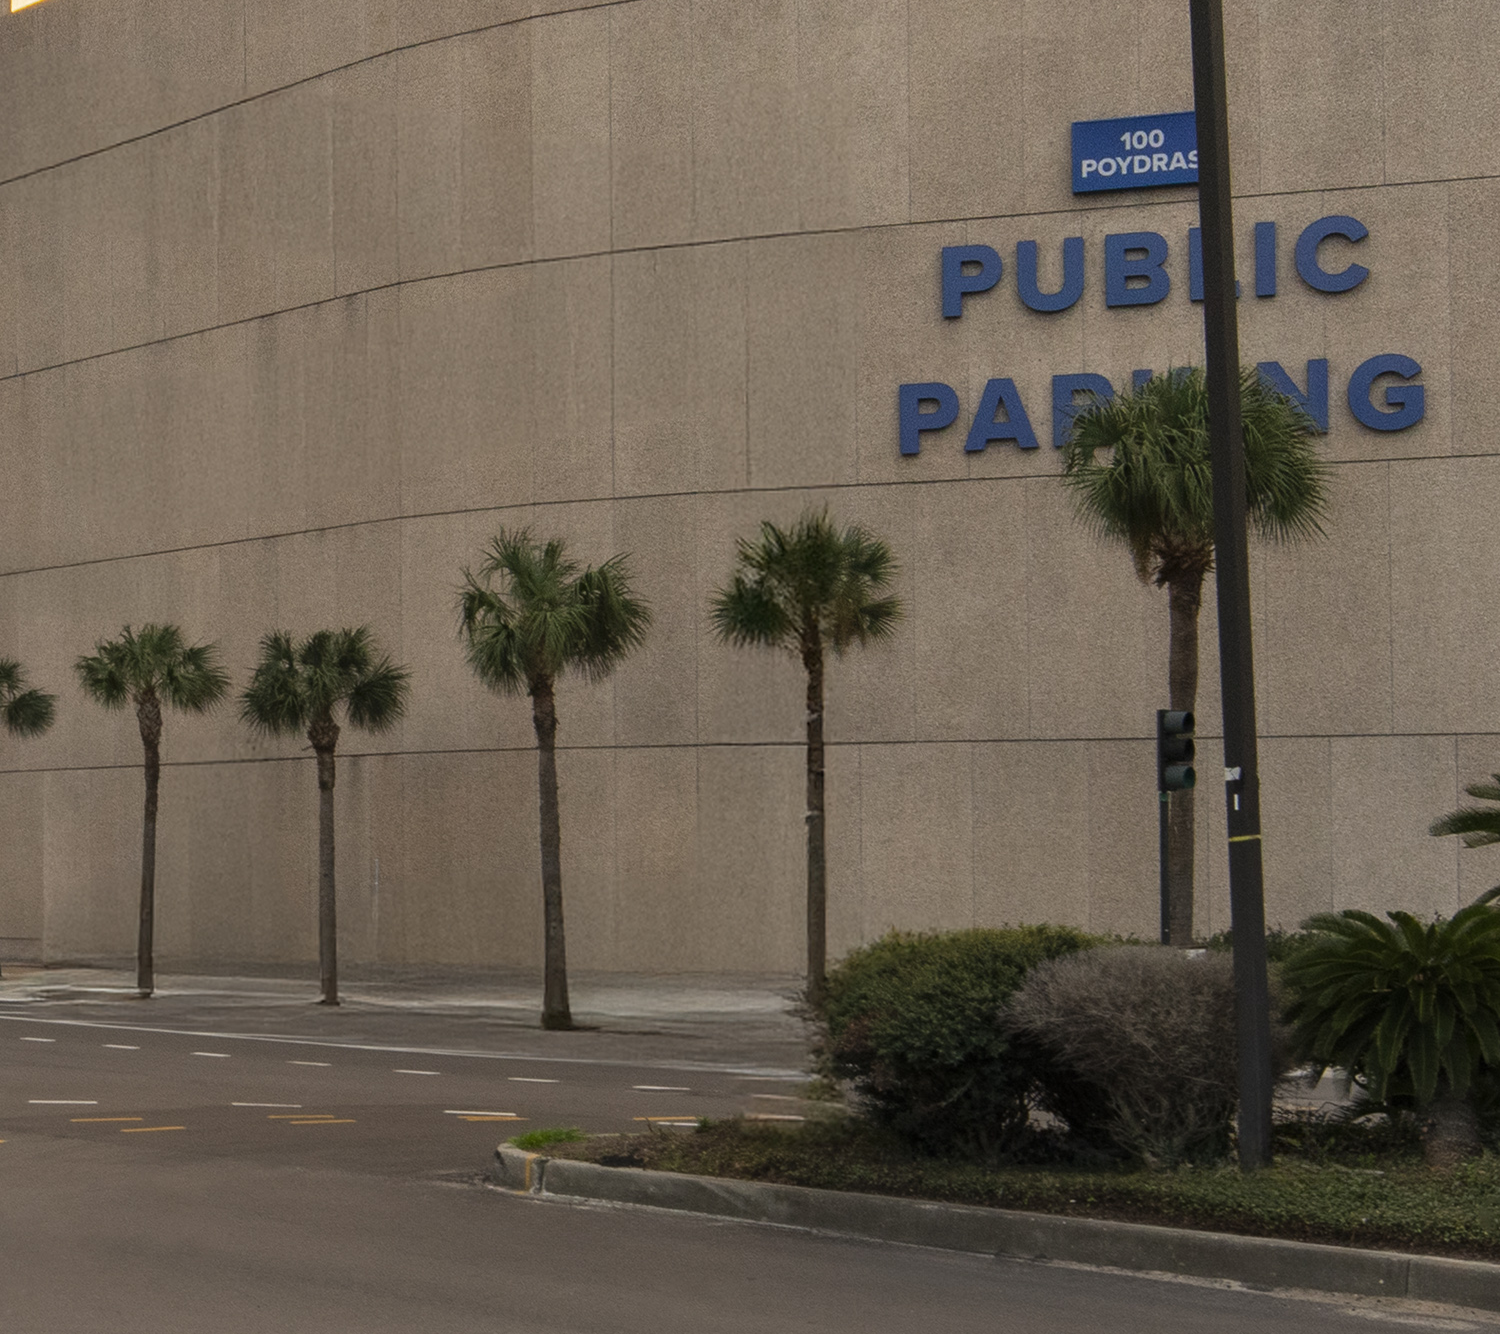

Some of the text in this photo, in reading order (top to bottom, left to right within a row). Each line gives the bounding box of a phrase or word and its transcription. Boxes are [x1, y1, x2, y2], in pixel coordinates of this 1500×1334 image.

[1119, 128, 1165, 151] 100
[1081, 149, 1199, 179] POYDRAS
[899, 352, 1426, 456] PARNG
